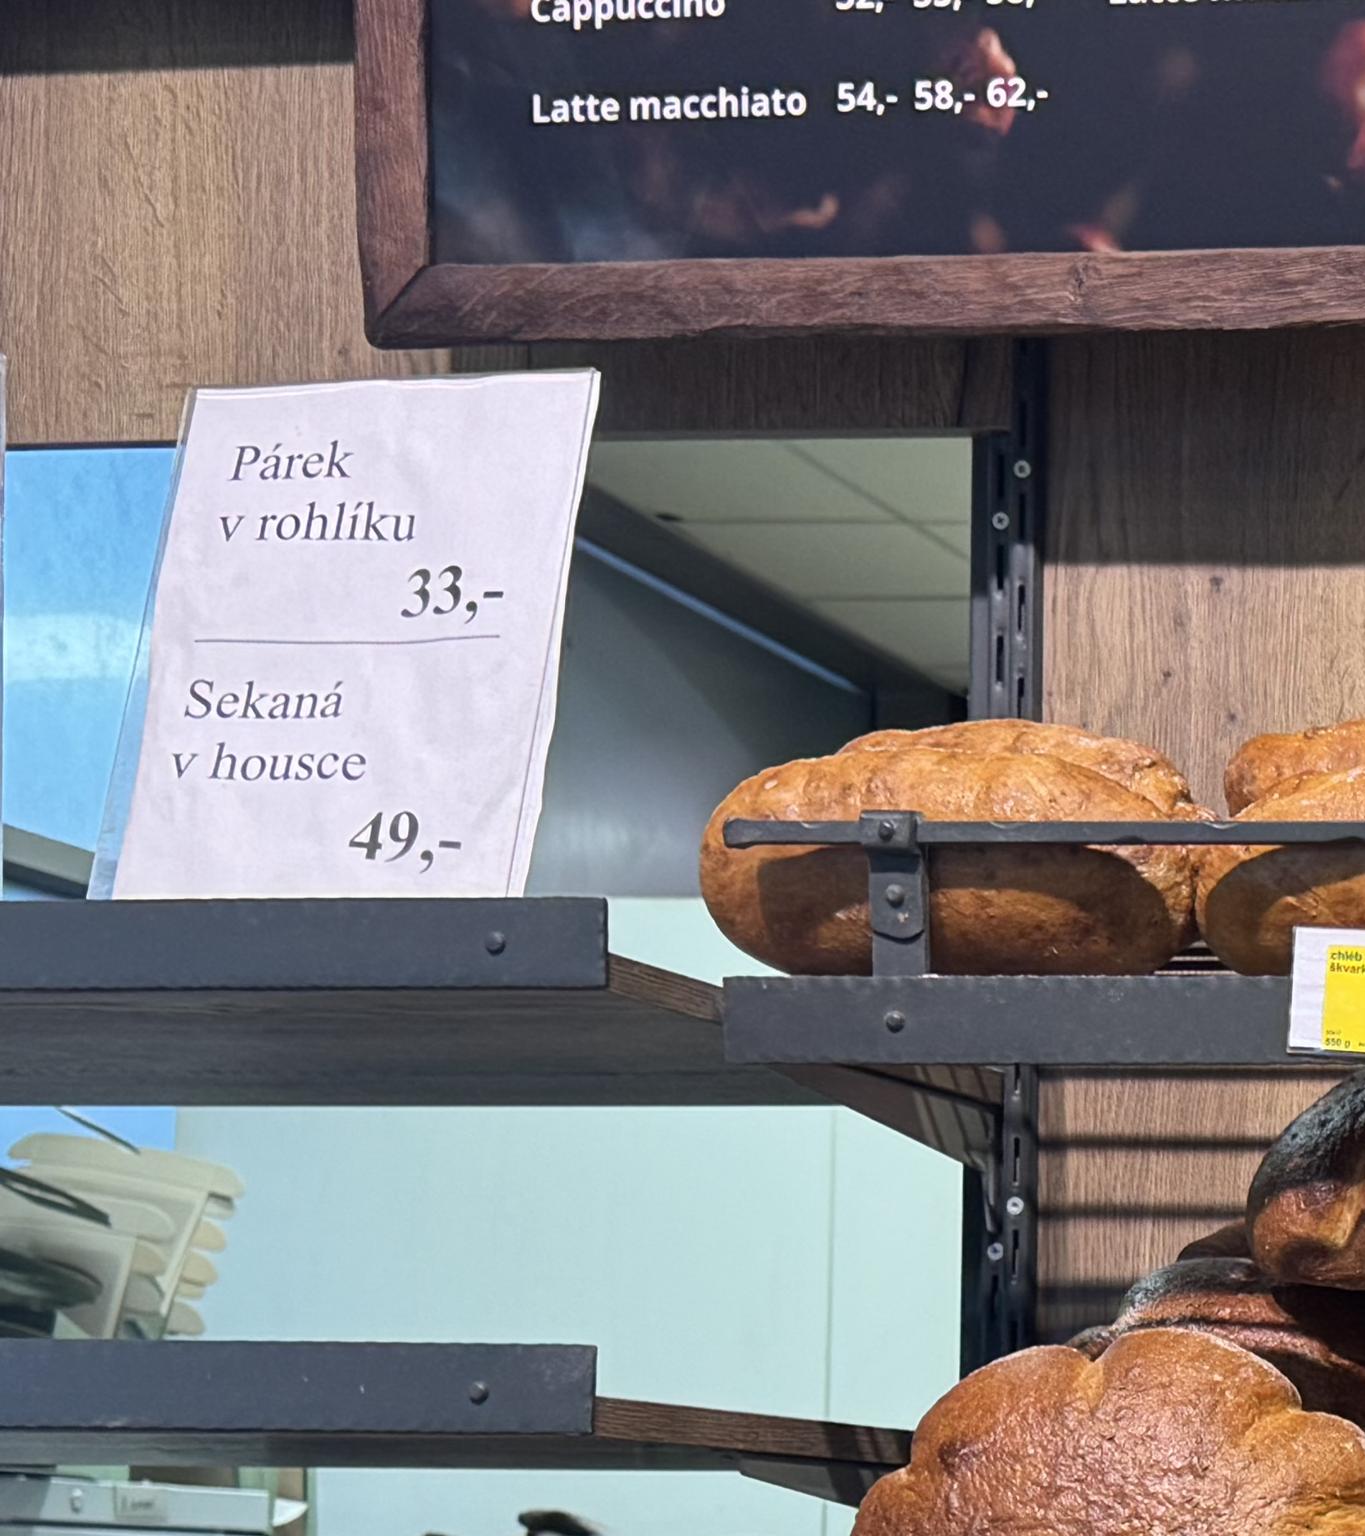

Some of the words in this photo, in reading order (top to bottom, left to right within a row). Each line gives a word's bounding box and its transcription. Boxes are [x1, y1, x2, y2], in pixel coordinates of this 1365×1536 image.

[531, 0, 725, 30] Cappuccino
[532, 93, 620, 125] Latte
[630, 85, 807, 121] macchiato
[836, 81, 898, 114] 54,-
[913, 79, 975, 113] 58,-
[987, 77, 1048, 111] 62,-
[228, 440, 354, 481] Párek
[219, 515, 242, 542] v
[256, 501, 418, 542] rohlíku
[400, 564, 505, 622] 33,-
[184, 679, 344, 720] Sekaná
[171, 753, 197, 780] v
[210, 742, 367, 782] housce
[348, 810, 462, 873] 49,-
[1330, 952, 1362, 962] chléb
